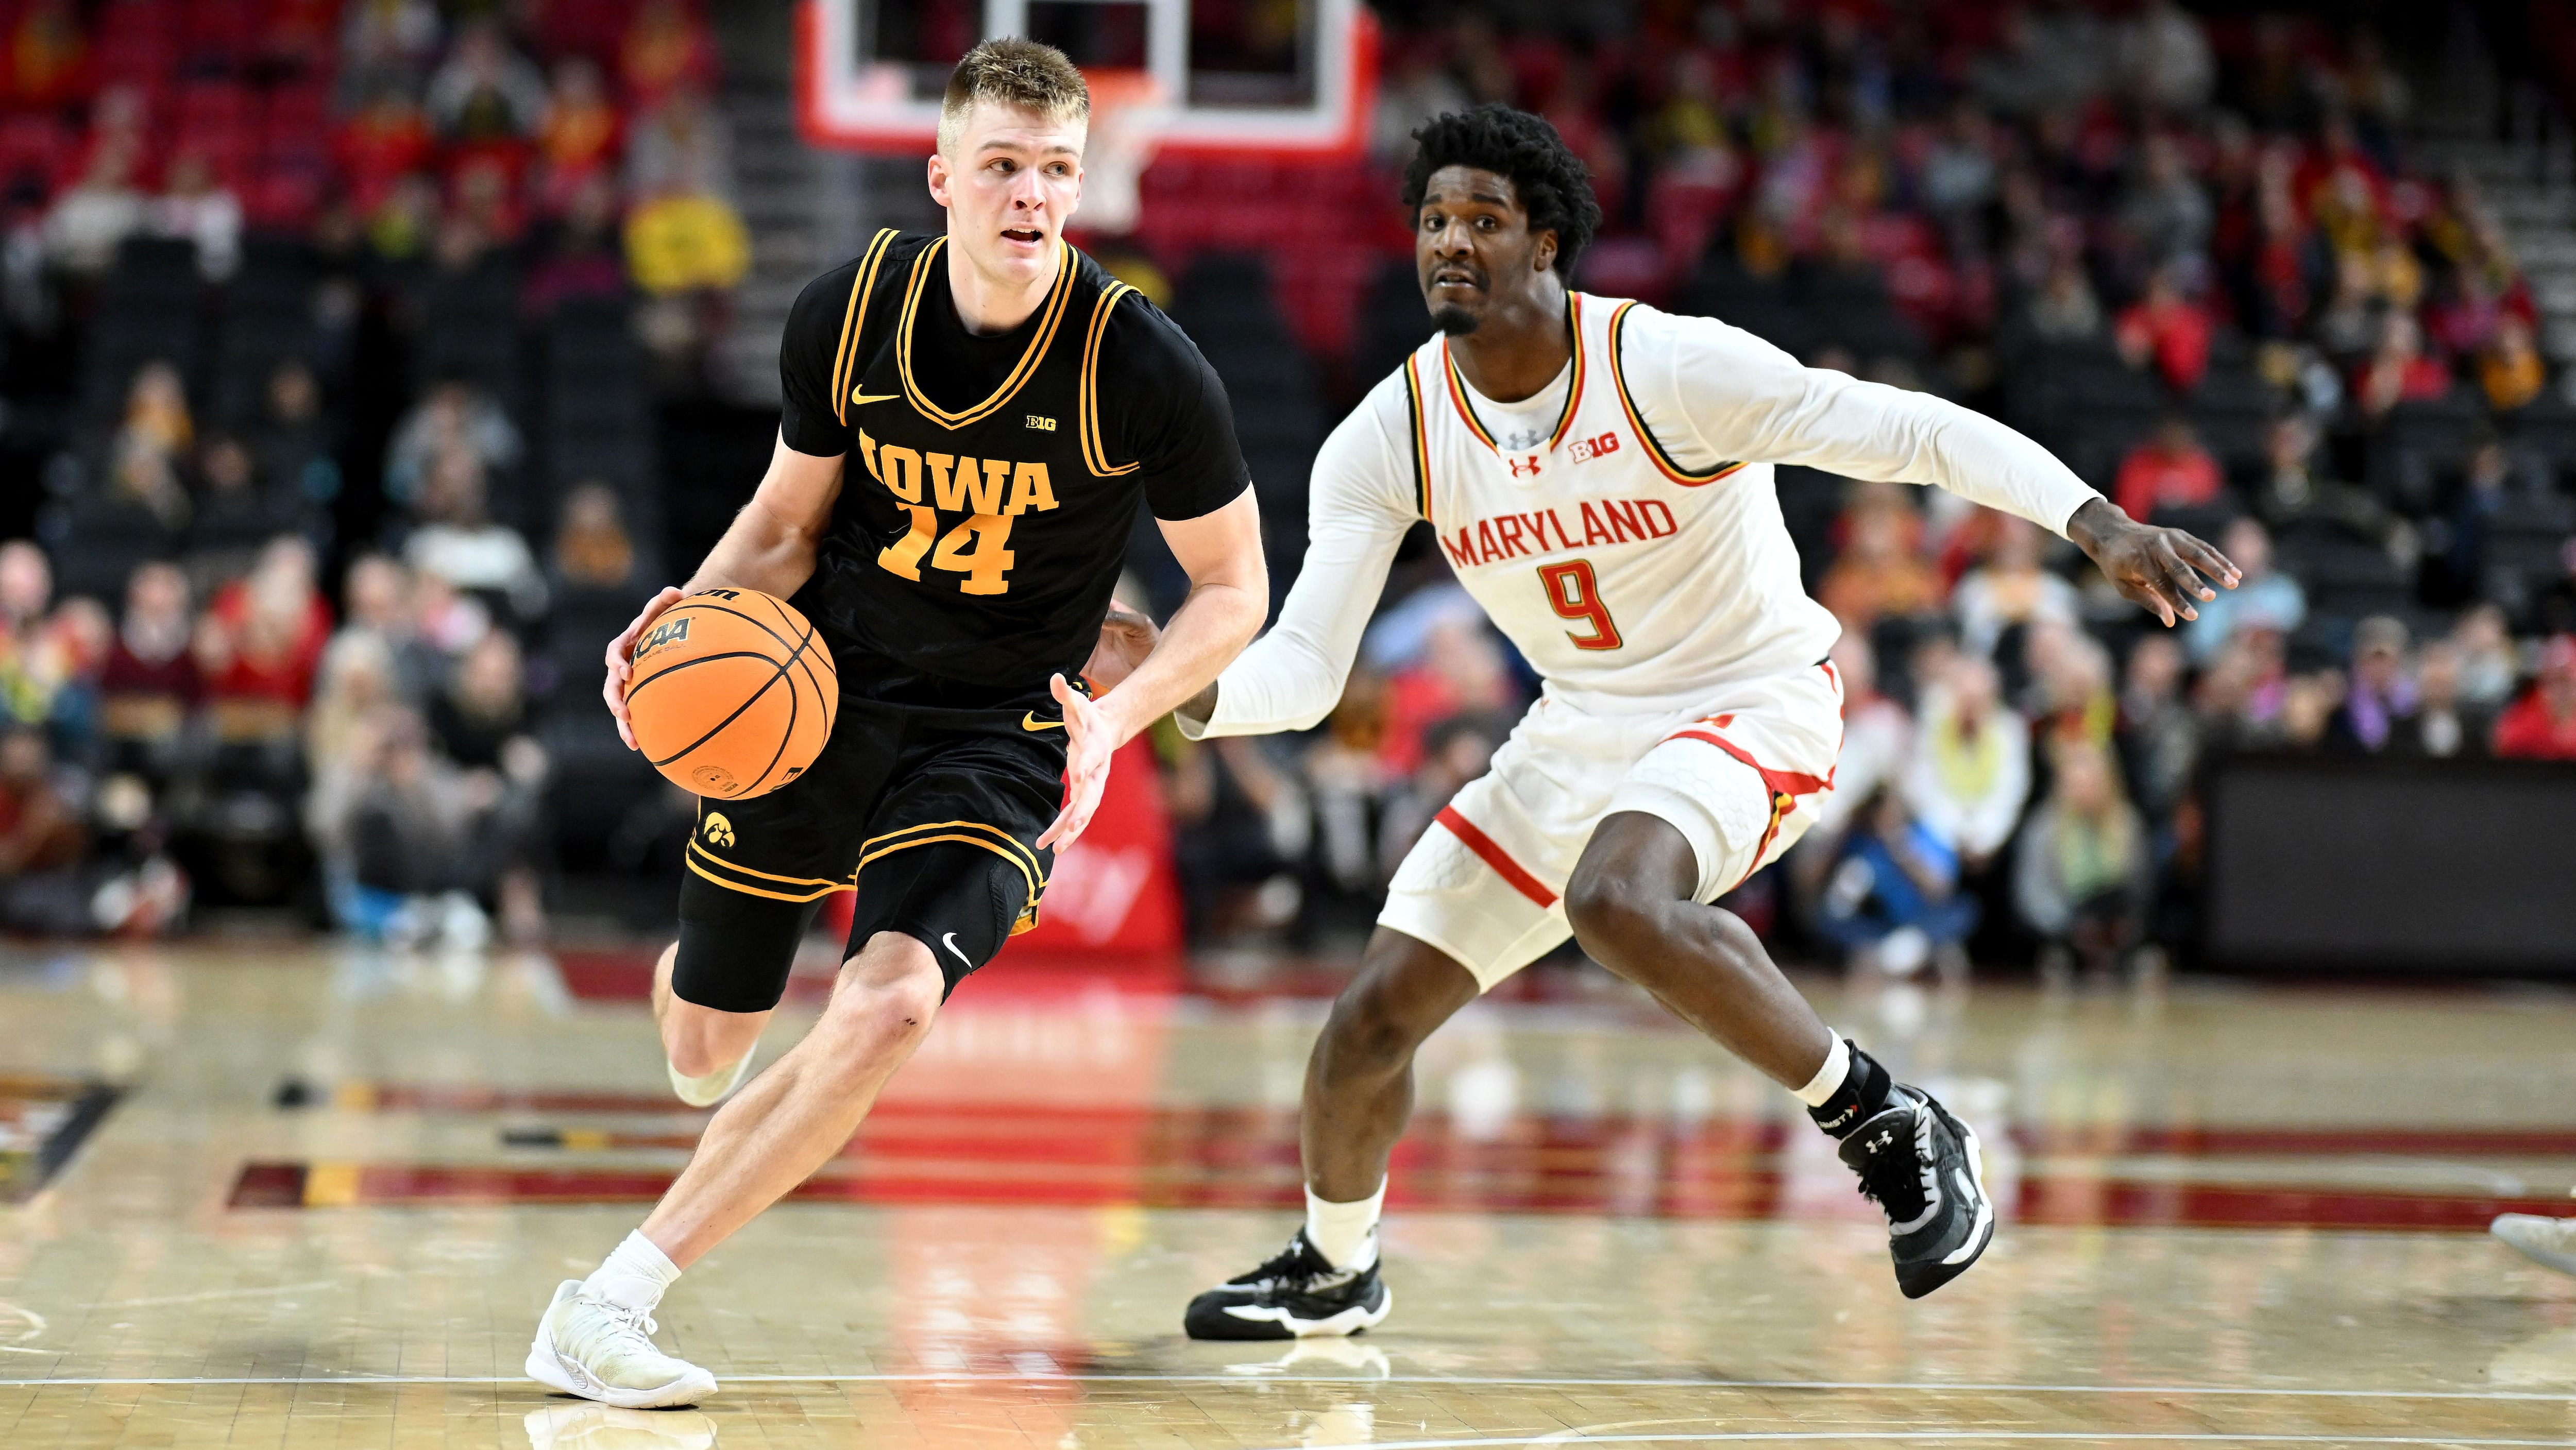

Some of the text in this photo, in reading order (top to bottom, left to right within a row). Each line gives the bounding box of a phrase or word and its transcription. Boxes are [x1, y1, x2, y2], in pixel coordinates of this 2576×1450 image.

[859, 427, 1059, 516] IOWA
[877, 502, 1015, 595] 14
[1442, 499, 1678, 569] MARYLAND
[1536, 558, 1623, 650] 9
